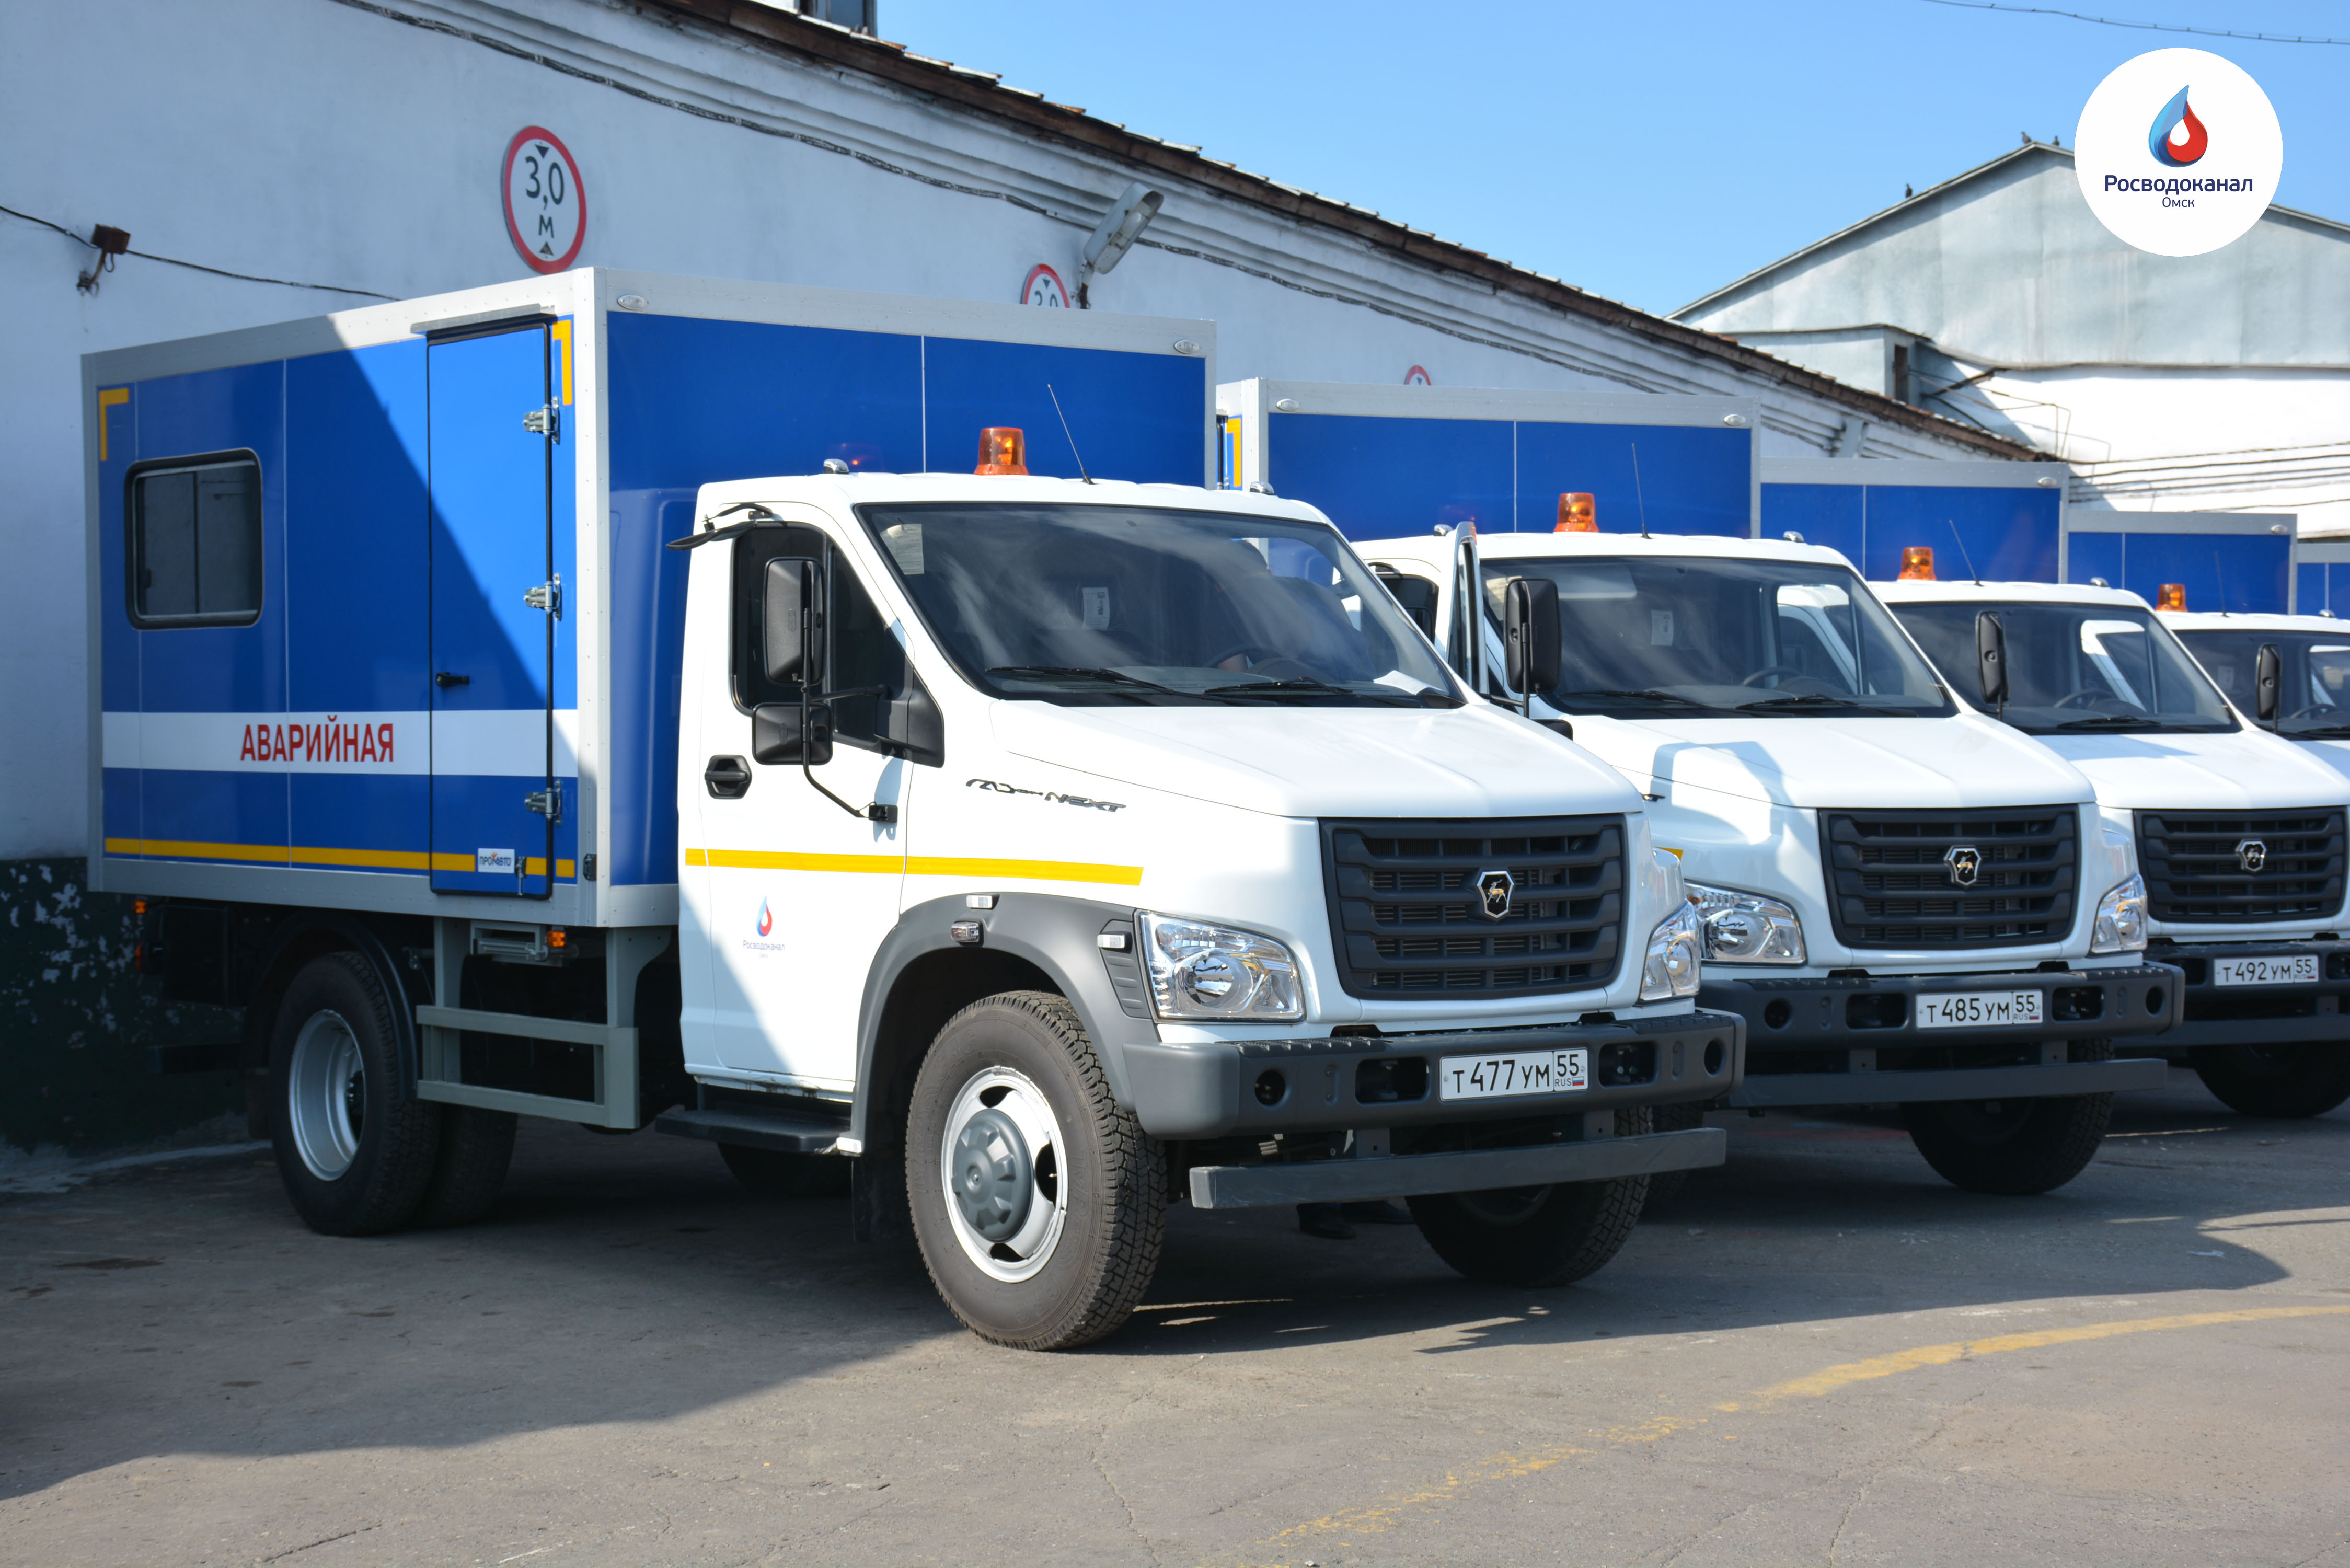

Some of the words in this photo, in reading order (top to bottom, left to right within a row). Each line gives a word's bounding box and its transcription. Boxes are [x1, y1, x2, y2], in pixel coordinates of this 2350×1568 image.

[525, 156, 564, 210] 3,0
[240, 714, 394, 762] АВАРИЙНАЯ
[2296, 959, 2312, 974] 55
[2015, 995, 2035, 1012] 55
[1557, 1054, 1579, 1077] 55
[1554, 1078, 1571, 1087] RUS
